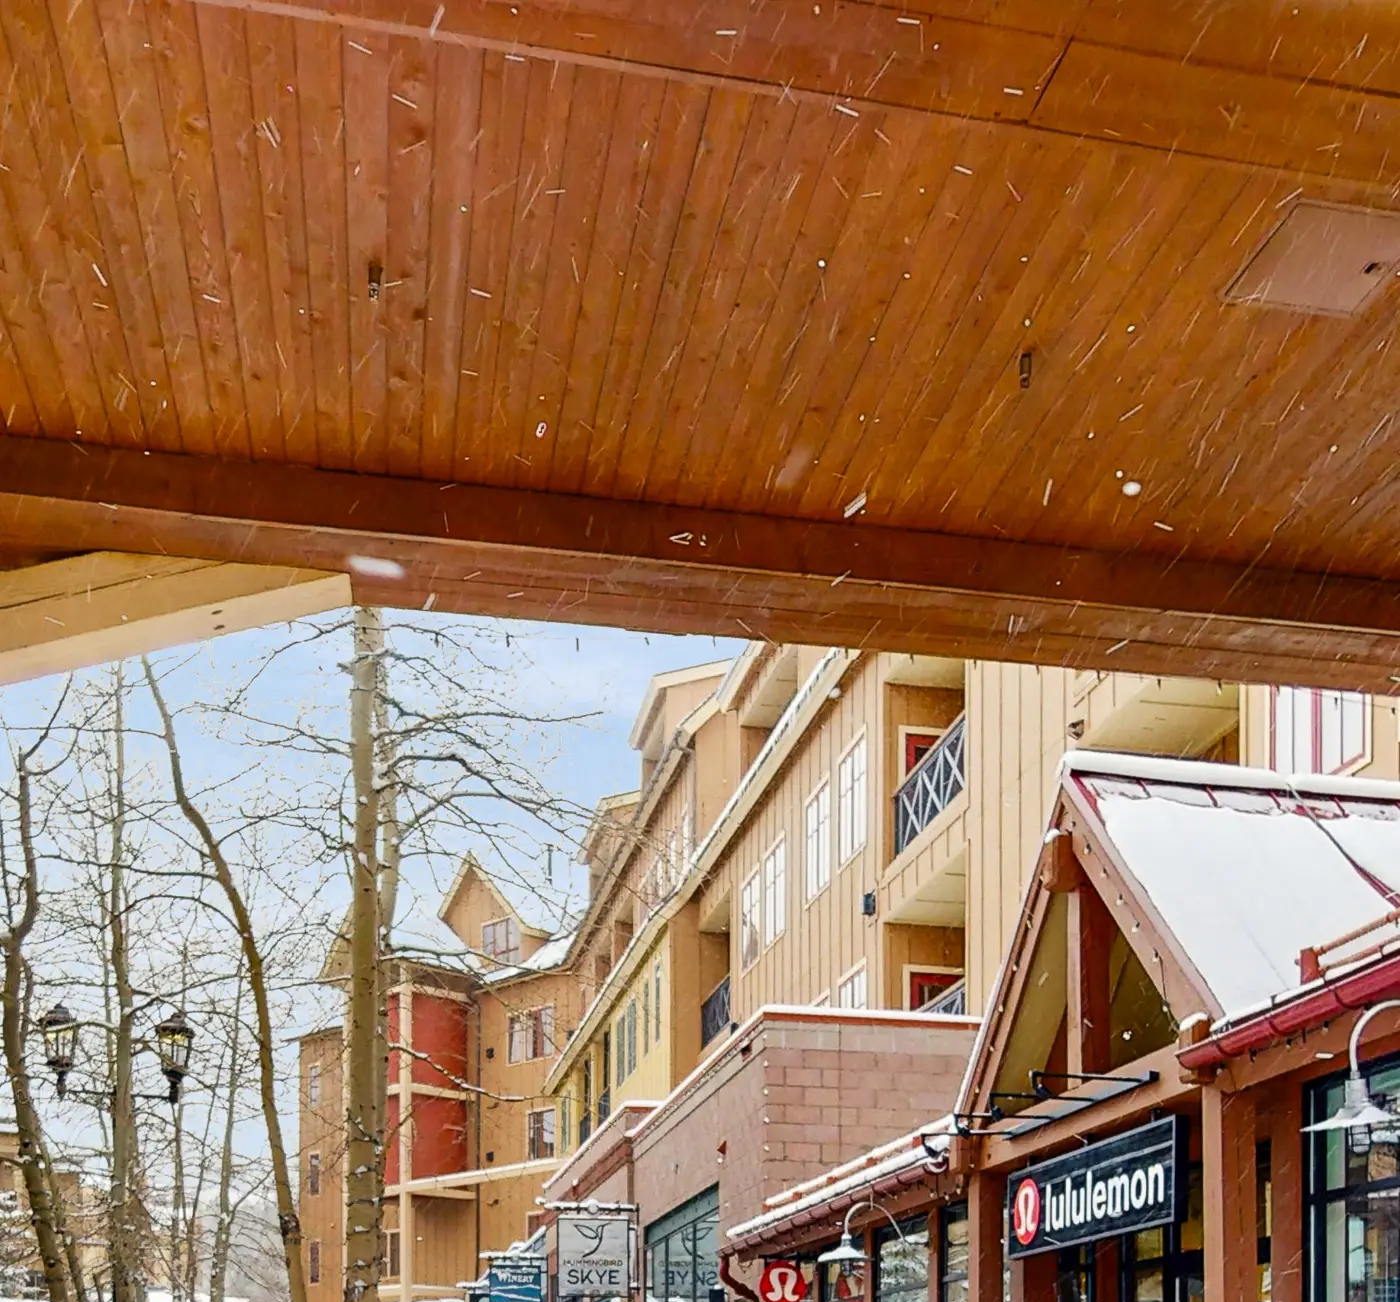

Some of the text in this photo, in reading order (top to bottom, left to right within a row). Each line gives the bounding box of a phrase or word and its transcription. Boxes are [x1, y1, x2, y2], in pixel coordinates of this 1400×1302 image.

[1044, 1163, 1165, 1233] lululemon
[562, 1259, 624, 1267] HUMMINGBIRD
[567, 1268, 621, 1285] SKYE
